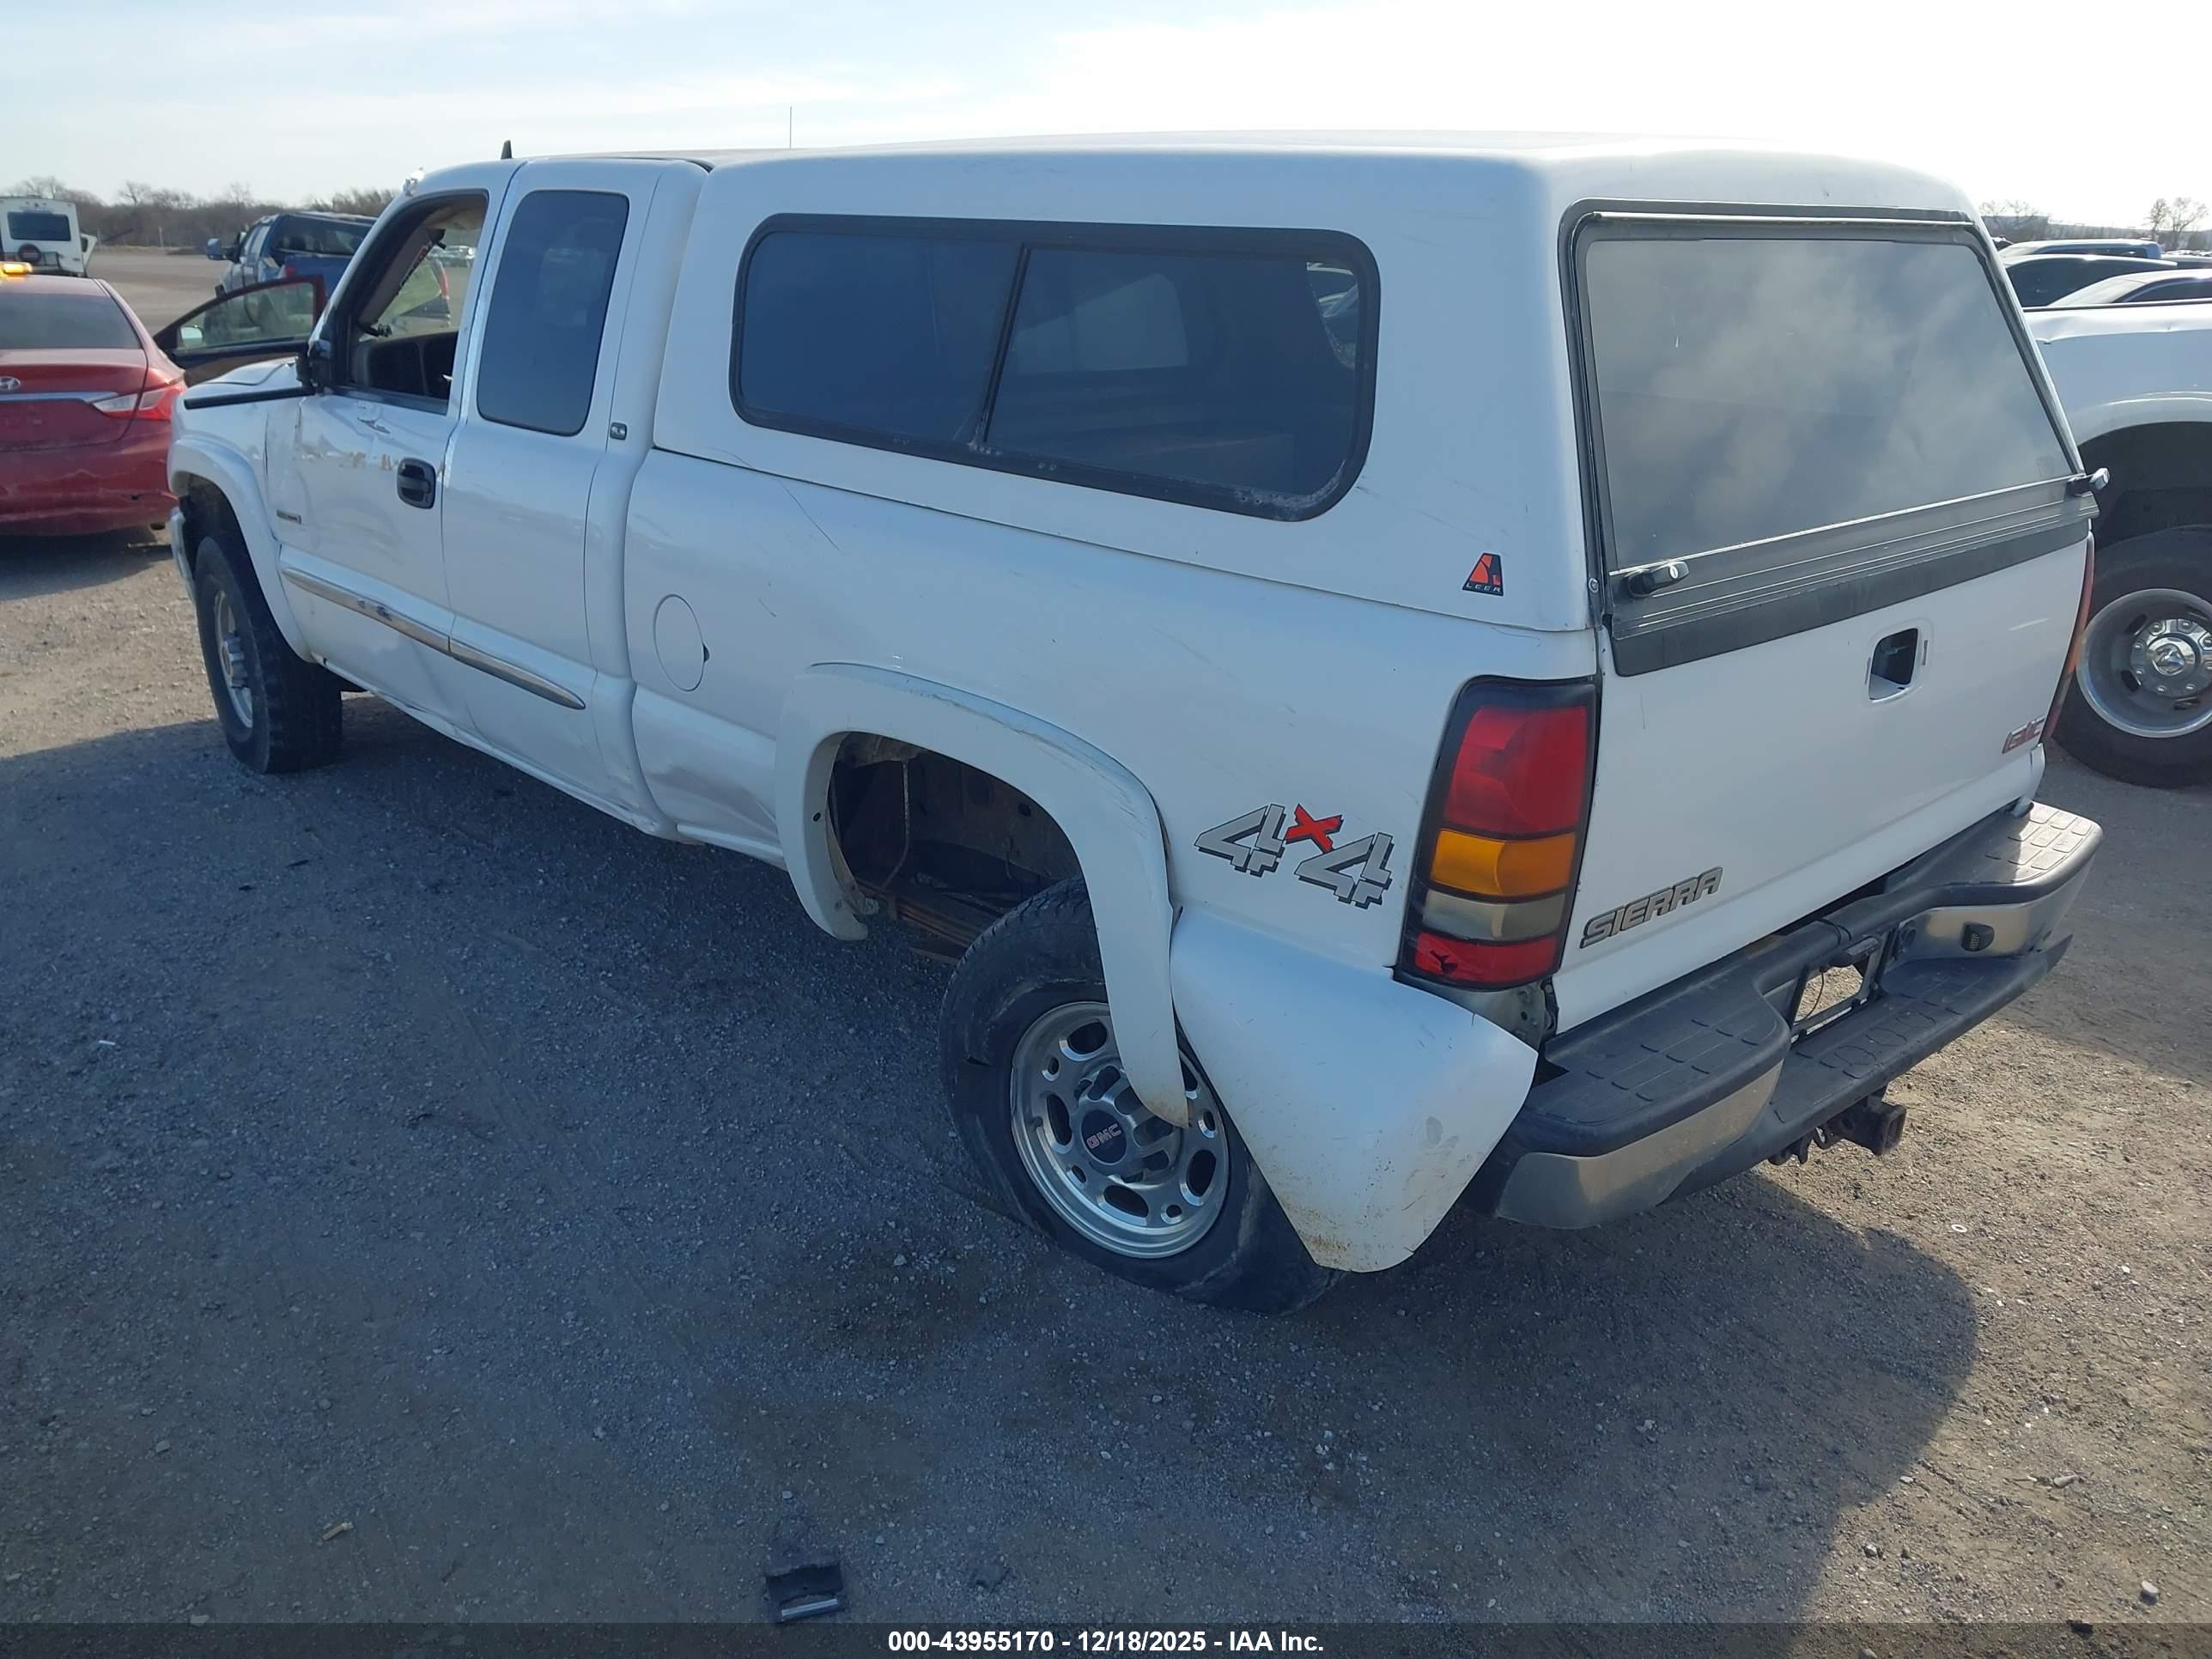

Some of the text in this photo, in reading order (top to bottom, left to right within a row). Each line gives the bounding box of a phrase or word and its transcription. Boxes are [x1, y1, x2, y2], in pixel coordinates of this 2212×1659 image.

[1466, 582, 1501, 592] LEER
[1579, 866, 1723, 949] SIERRA
[1086, 1123, 1121, 1149] GMC
